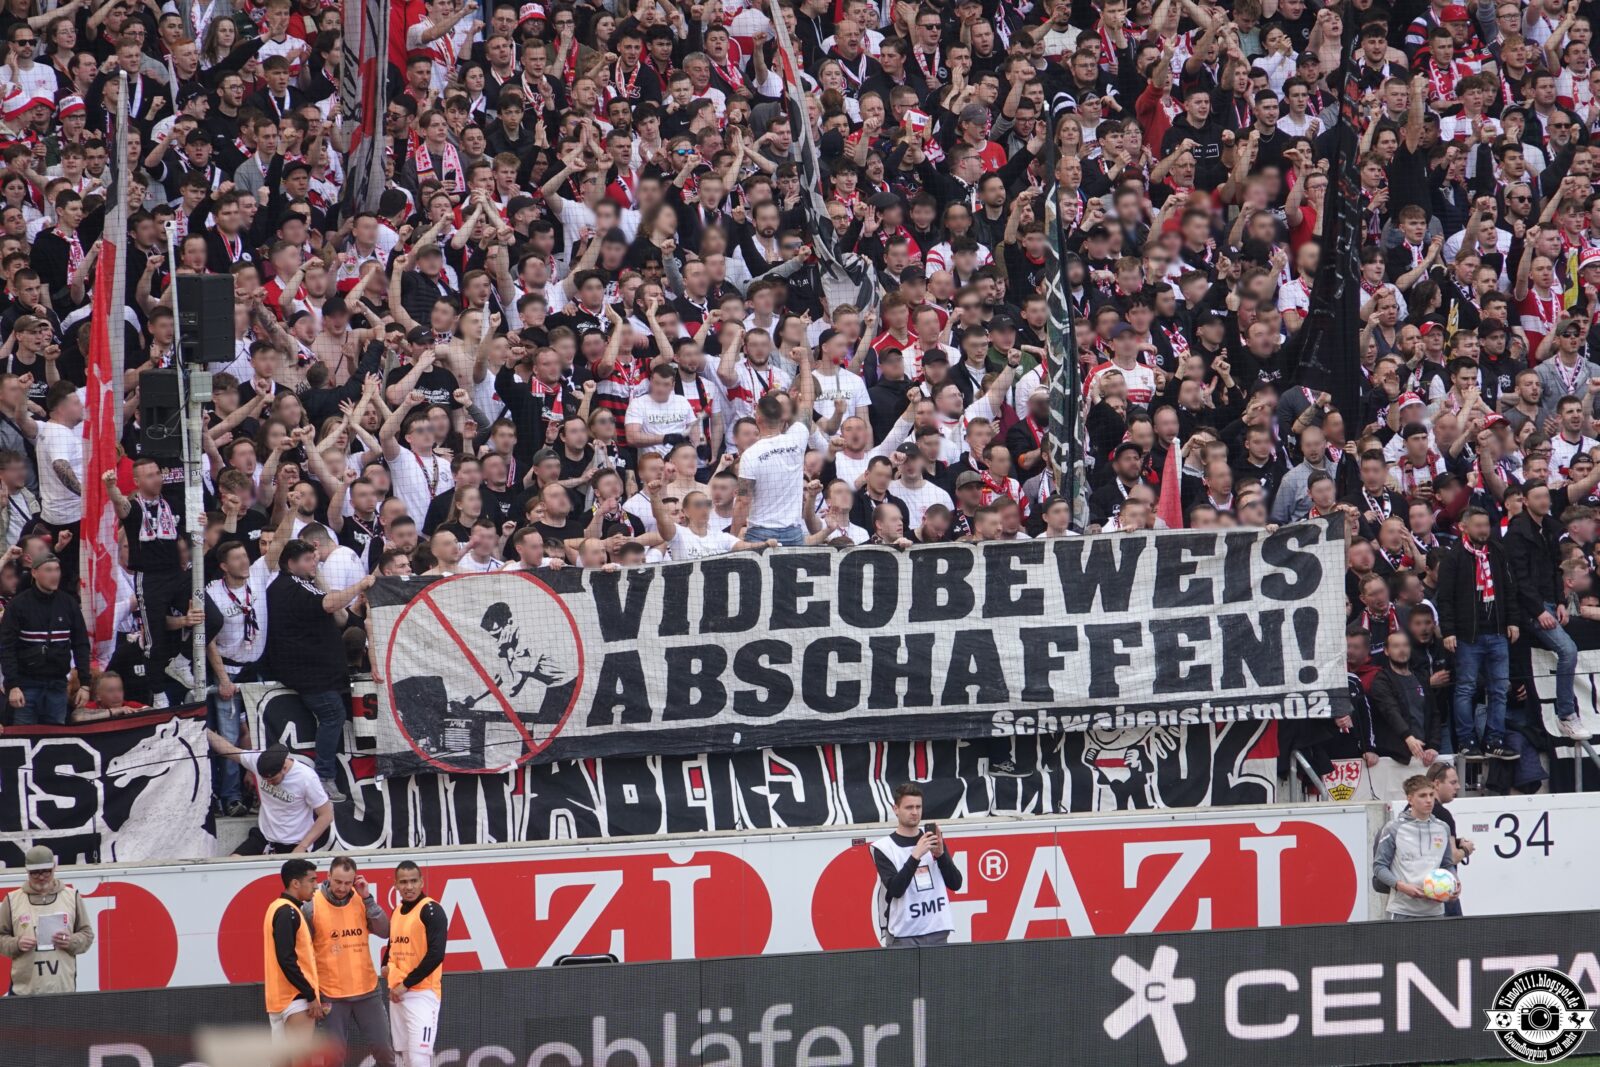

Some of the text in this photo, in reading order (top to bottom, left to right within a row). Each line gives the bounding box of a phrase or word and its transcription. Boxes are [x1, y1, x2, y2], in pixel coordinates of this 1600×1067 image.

[588, 521, 1324, 643] VIDEOBEWEIS
[586, 605, 1320, 728] ABSCHAFFEN!
[1494, 811, 1554, 859] 34
[909, 896, 946, 919] SMF
[341, 928, 363, 937] JAKO
[394, 936, 410, 944] JAKO
[34, 959, 60, 977] TV
[423, 1026, 432, 1043] 11
